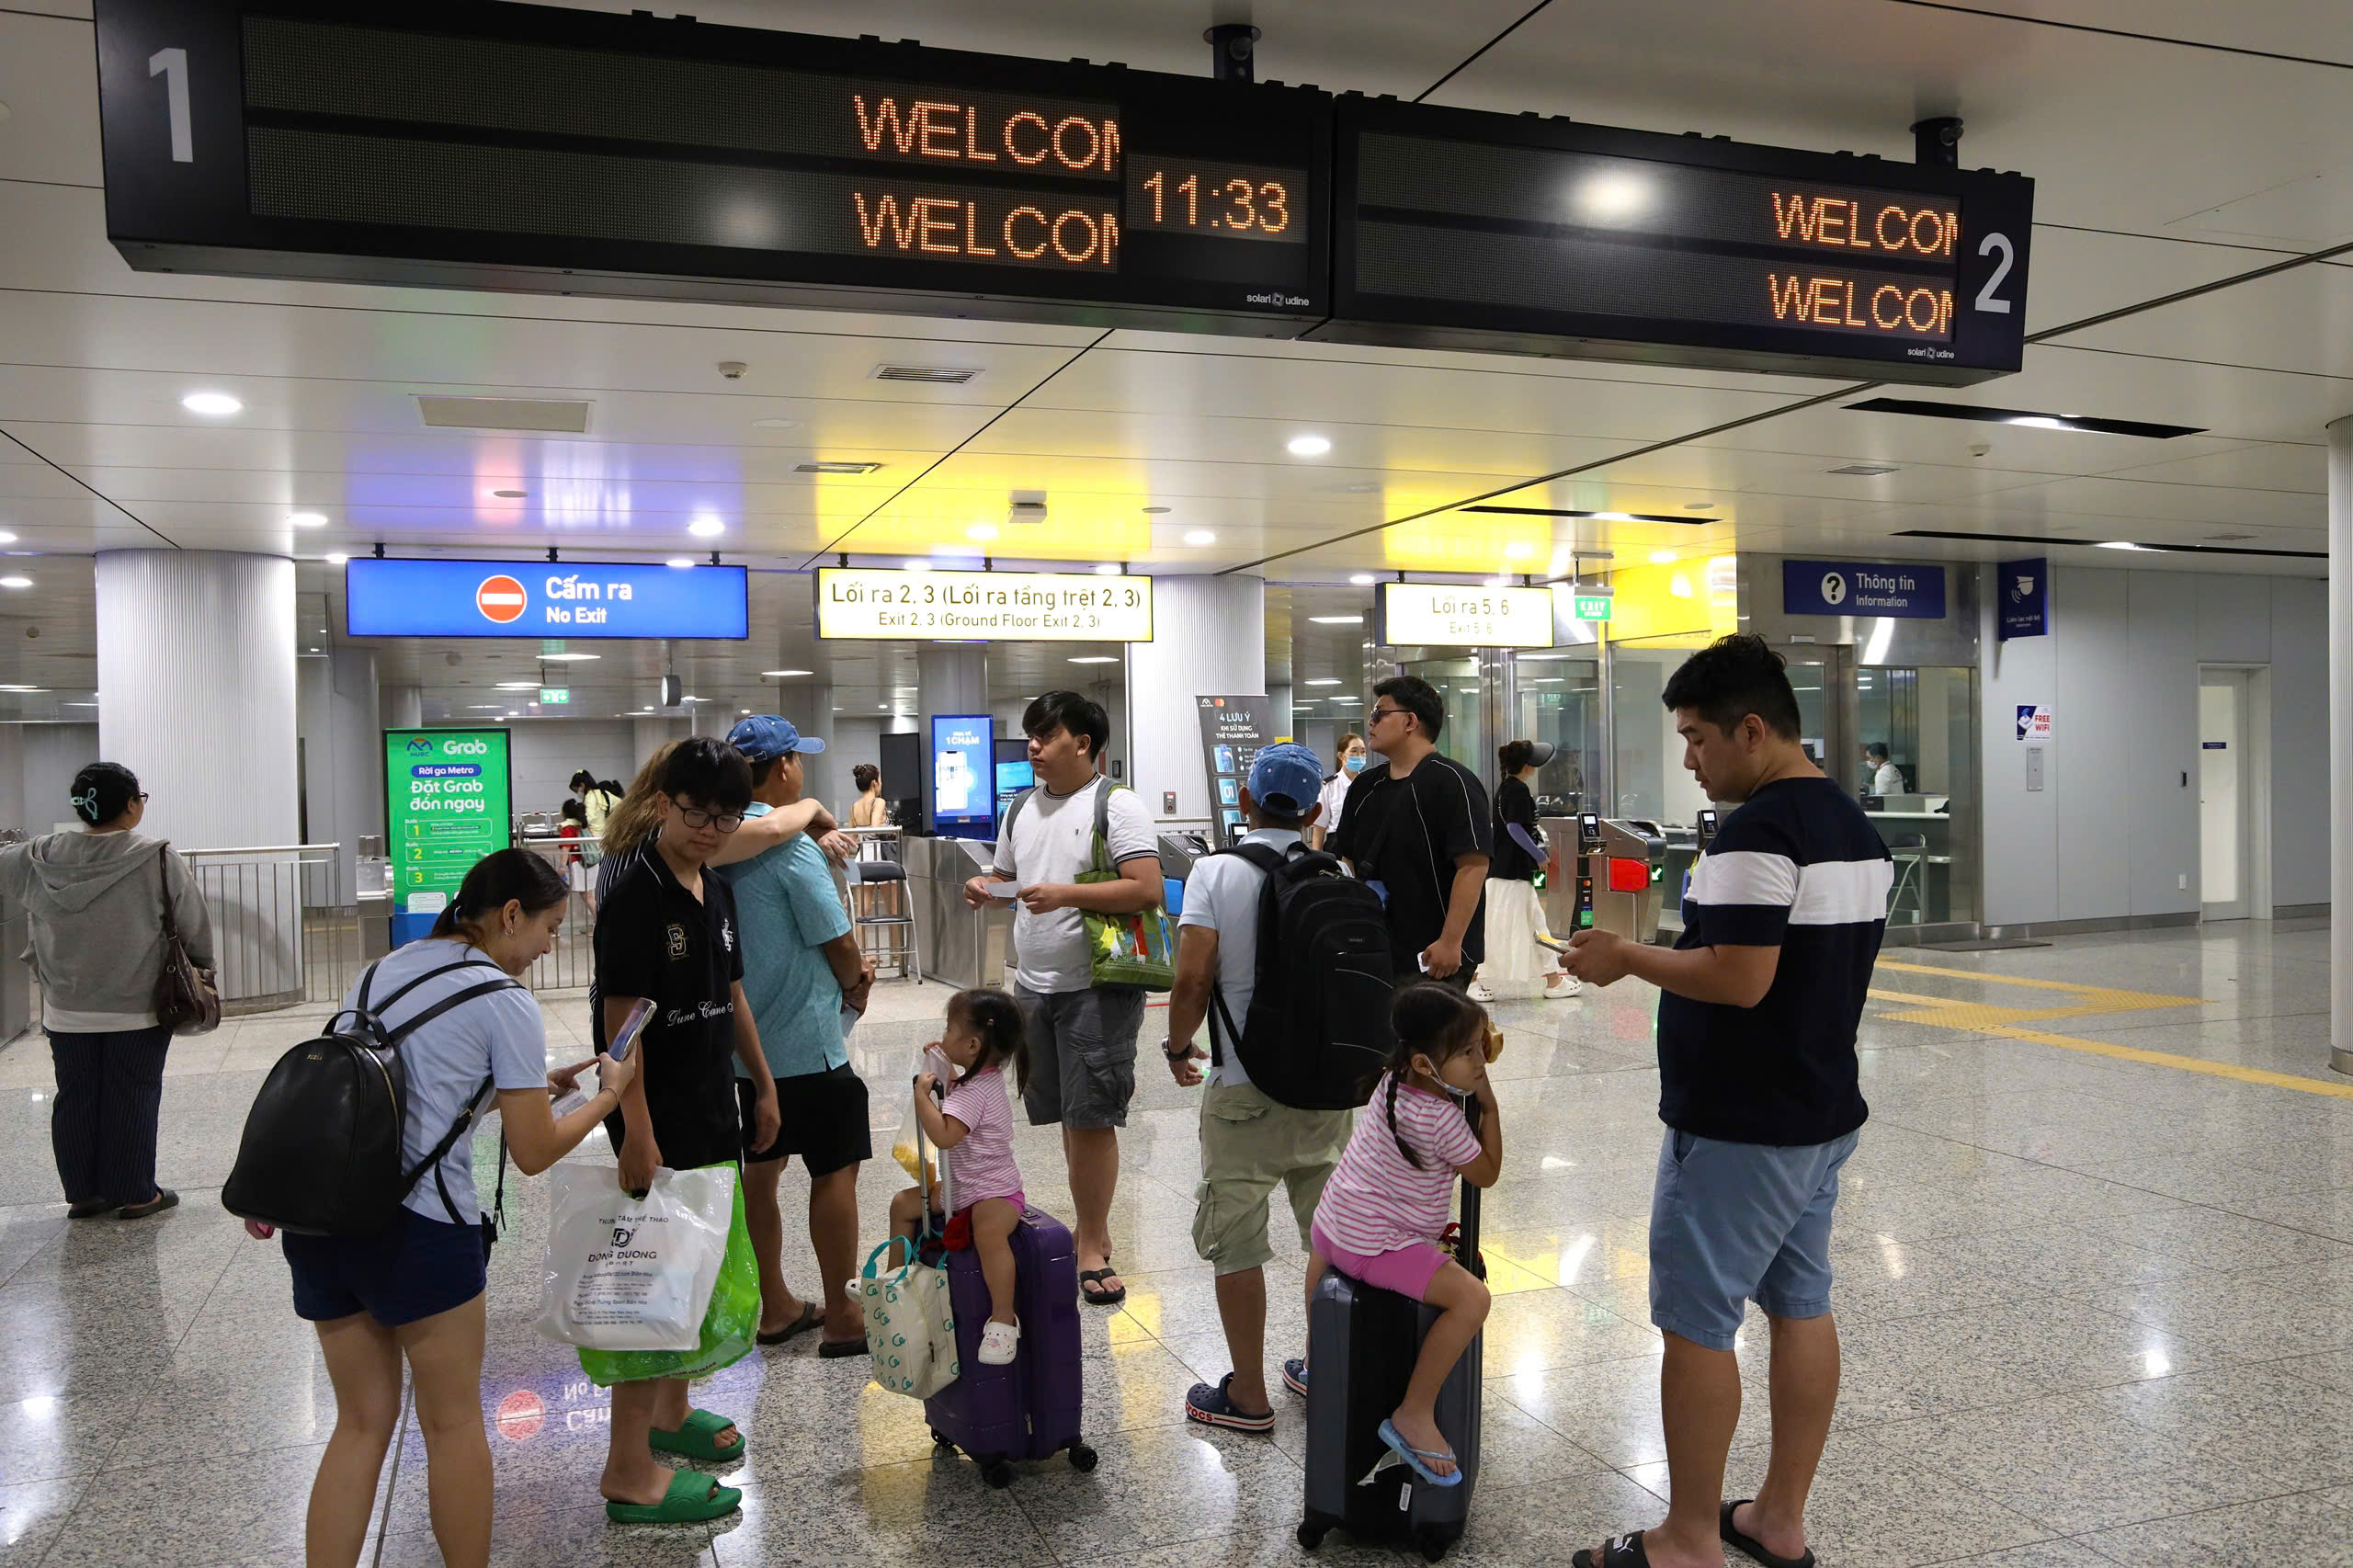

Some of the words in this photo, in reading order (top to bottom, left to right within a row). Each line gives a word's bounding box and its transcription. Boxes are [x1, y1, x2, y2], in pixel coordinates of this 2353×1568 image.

[149, 47, 193, 163] 1
[1143, 171, 1289, 233] 11:33
[1974, 232, 2015, 313] 2
[1246, 293, 1271, 303] solari
[1285, 296, 1310, 306] udine
[1907, 347, 1927, 357] solari
[1936, 349, 1955, 359] udine
[545, 574, 600, 600] Cấm
[607, 583, 633, 600] ra
[1855, 573, 1896, 594] Thông
[1899, 574, 1915, 591] tin
[832, 581, 864, 603] Lối
[871, 588, 893, 603] ra
[924, 585, 935, 604] 3
[942, 583, 980, 606] (Lối
[986, 591, 1007, 606] ra
[1014, 585, 1056, 610] tầng
[1063, 588, 1097, 611] trệt
[1124, 588, 1142, 608] 3)
[1856, 595, 1908, 608] Information
[546, 606, 571, 623] No
[575, 606, 608, 624] Exit
[1461, 602, 1477, 615] ra
[1501, 599, 1509, 616] 6
[879, 611, 905, 626] Exit
[926, 612, 936, 626] 3
[939, 612, 998, 627] (Ground
[1002, 613, 1039, 628] Floor
[1043, 614, 1069, 628] Exit
[1219, 712, 1225, 722] 4
[2034, 714, 2051, 722] FREE
[2035, 723, 2050, 732] WIFI
[443, 738, 488, 756] Grab
[434, 768, 447, 777] ga
[447, 767, 474, 775] Metro
[410, 779, 441, 797] Đặt
[443, 778, 484, 793] Grab
[409, 796, 441, 811] đón
[443, 799, 485, 813] ngay
[413, 824, 419, 836] 1
[414, 847, 423, 860] 2
[415, 872, 423, 883] 3
